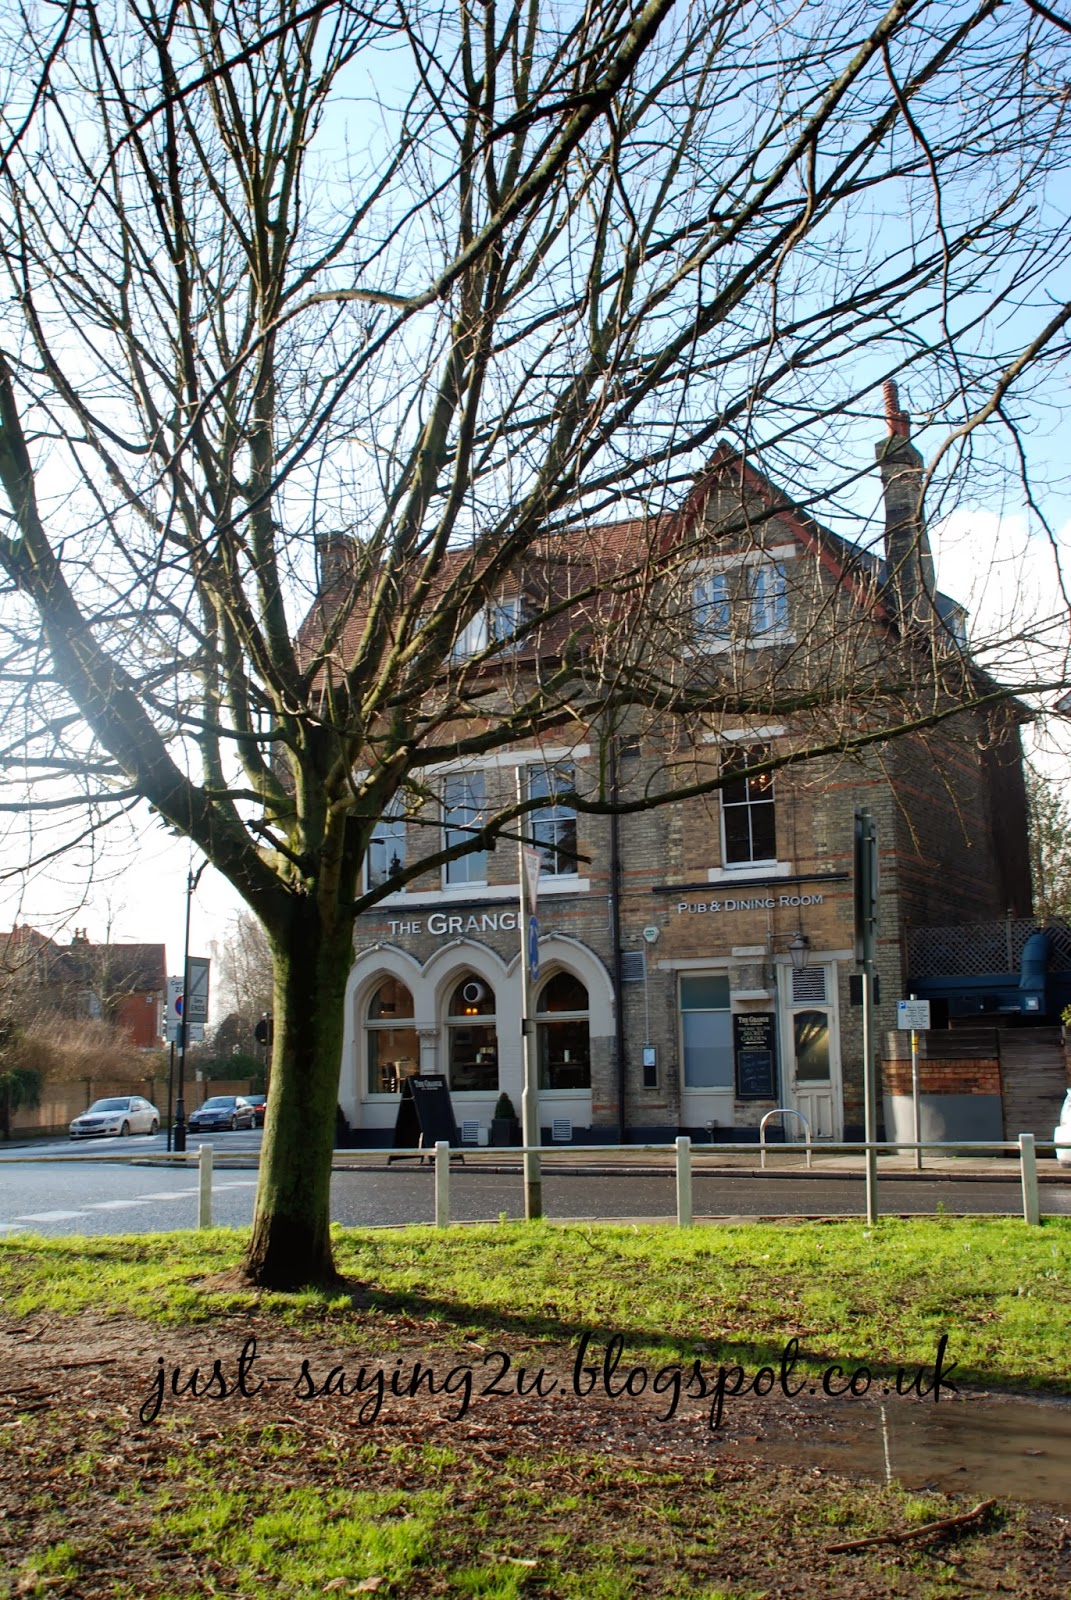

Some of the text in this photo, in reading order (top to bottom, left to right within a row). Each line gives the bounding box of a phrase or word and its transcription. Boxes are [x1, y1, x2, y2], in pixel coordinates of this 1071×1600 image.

[677, 895, 823, 914] PUB & DINING ROOM
[387, 920, 422, 935] THE
